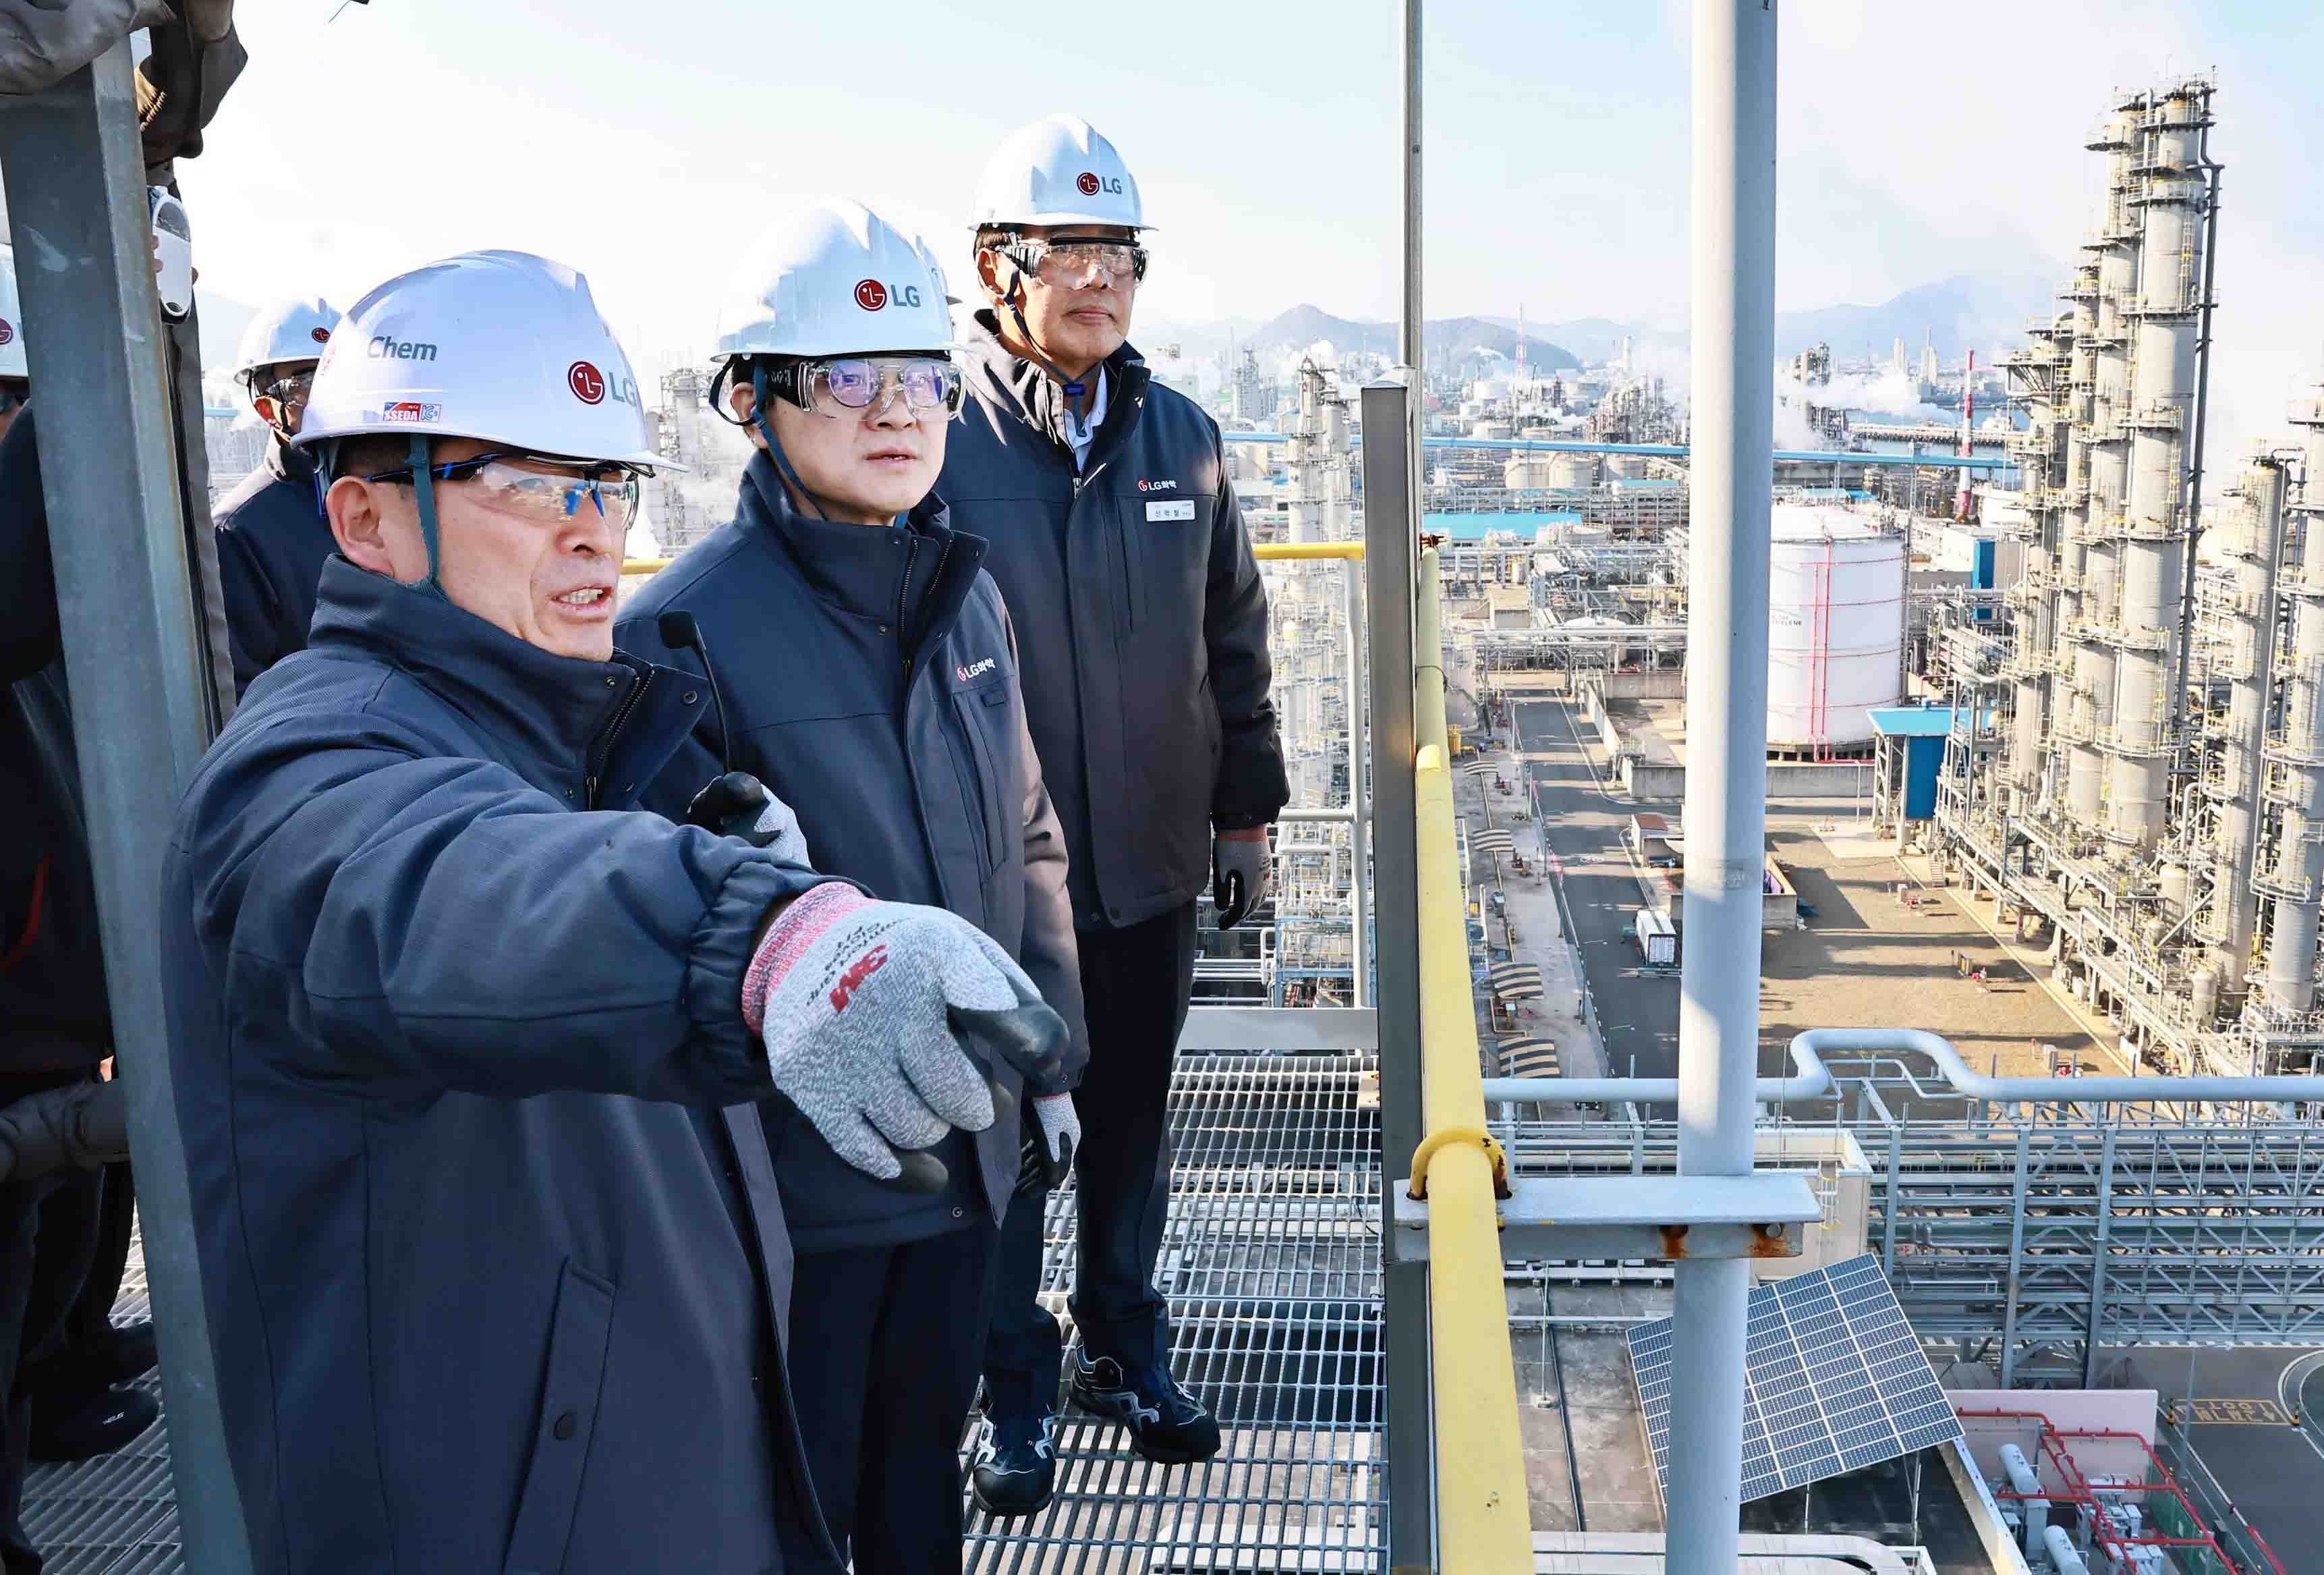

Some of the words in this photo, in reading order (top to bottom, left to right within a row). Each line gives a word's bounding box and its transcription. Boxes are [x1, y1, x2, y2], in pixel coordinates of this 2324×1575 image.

[1100, 176, 1123, 195] LG
[890, 284, 921, 308] LG
[368, 335, 437, 361] Chem
[608, 372, 638, 407] LG
